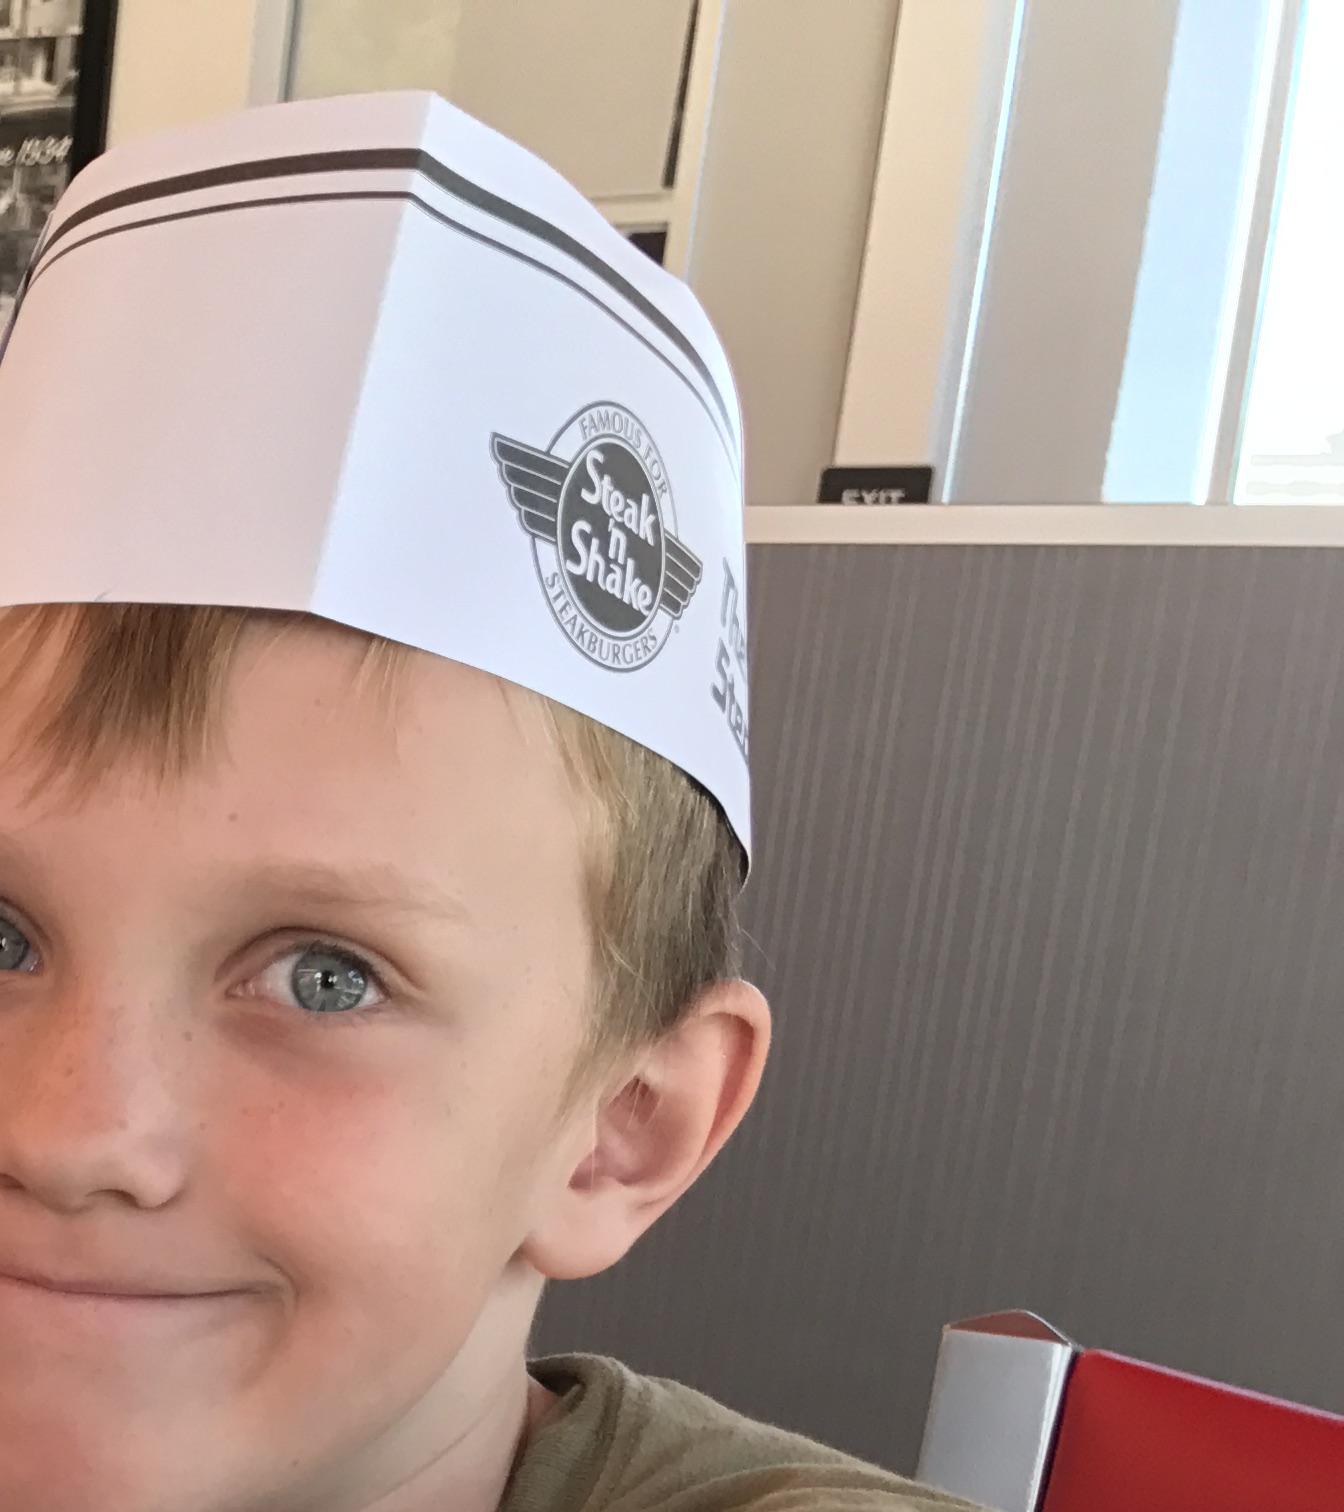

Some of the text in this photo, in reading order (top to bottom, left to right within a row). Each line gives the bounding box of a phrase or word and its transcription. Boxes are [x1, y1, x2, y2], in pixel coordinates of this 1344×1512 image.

[578, 409, 668, 497] FAMOUS FOR
[580, 449, 656, 547] Steak
[565, 519, 653, 617] Shake
[544, 571, 658, 666] STEAKBURGERS
